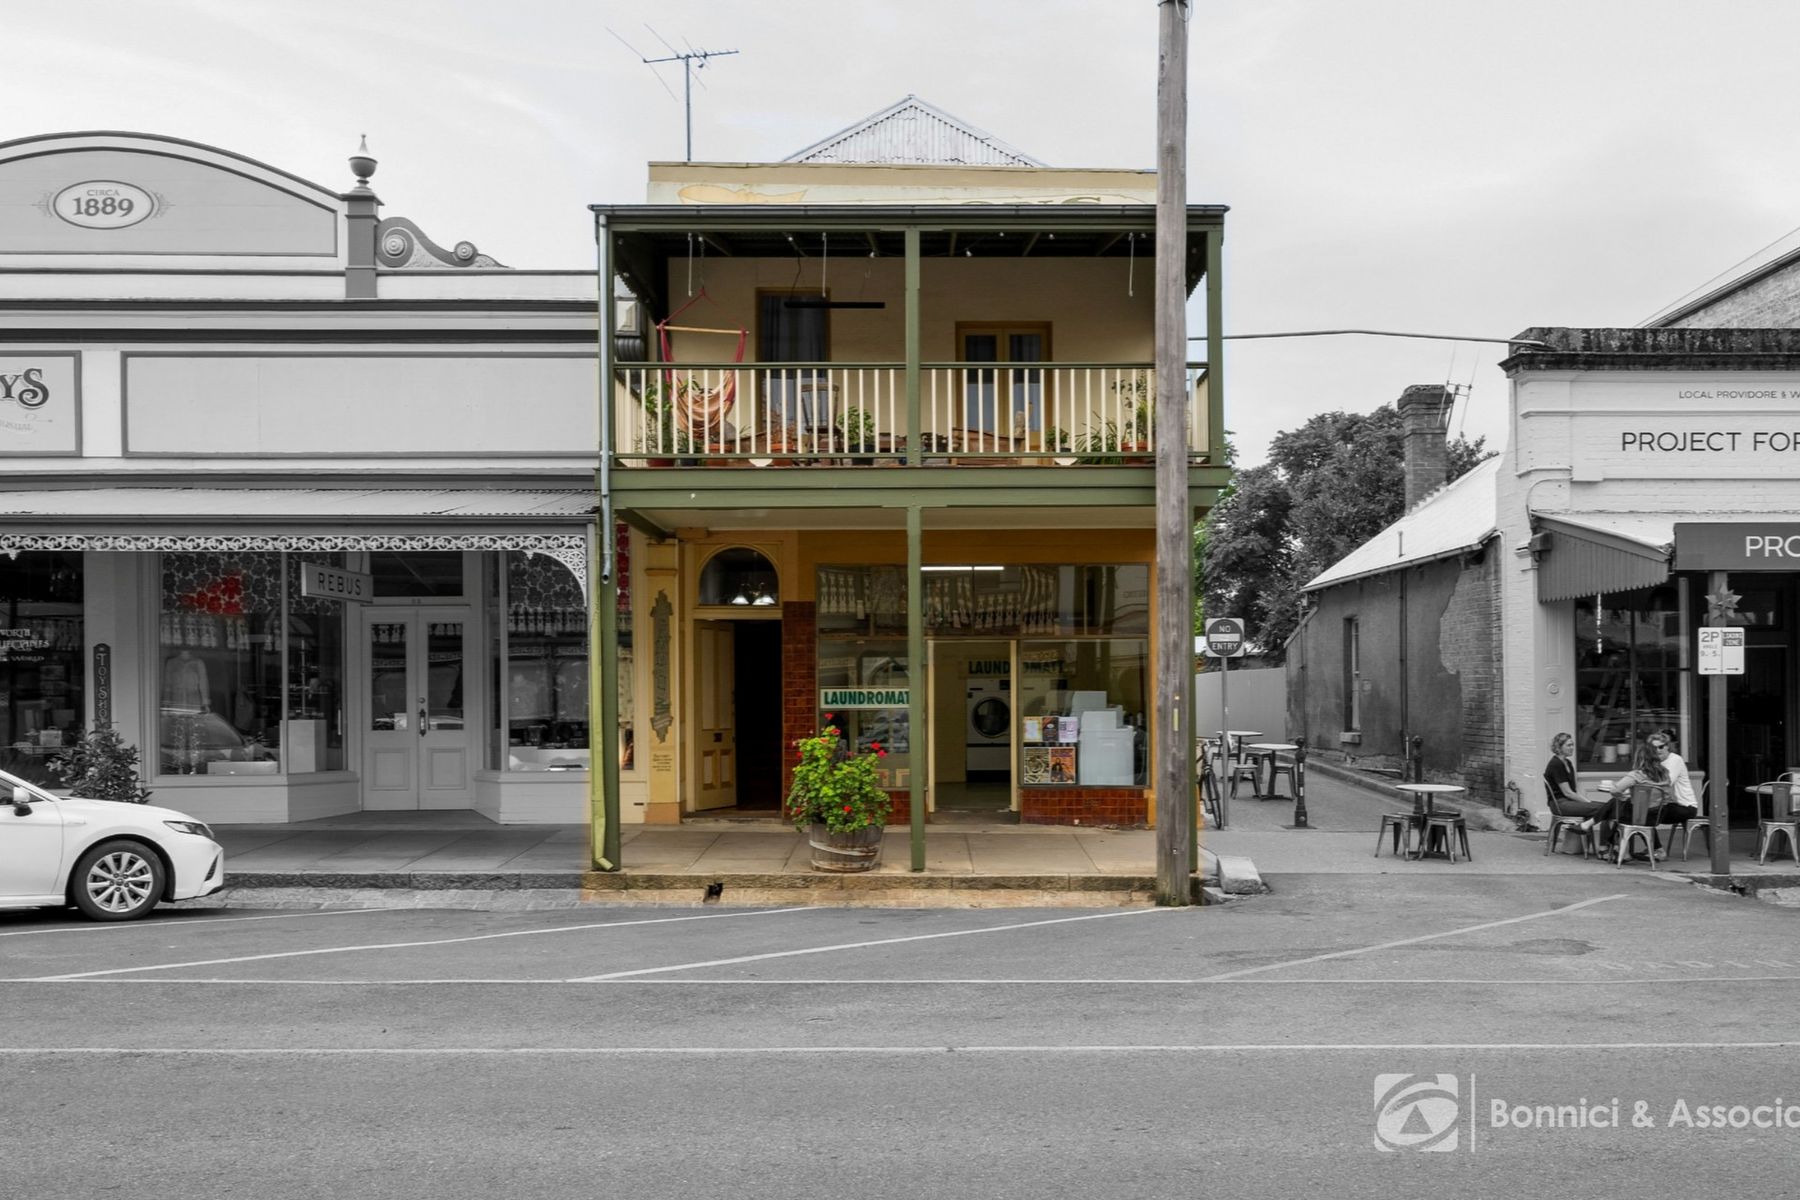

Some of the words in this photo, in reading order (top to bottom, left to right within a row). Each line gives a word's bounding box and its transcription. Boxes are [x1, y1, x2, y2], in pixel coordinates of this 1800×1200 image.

[86, 189, 121, 197] CIRCA
[72, 197, 134, 217] 1889
[1679, 390, 1713, 399] LOCAL
[1716, 390, 1777, 399] PROVIDORE
[1622, 431, 1742, 452] PROJECT
[1745, 535, 1800, 557] PRO
[318, 572, 362, 596] REBUS
[1218, 625, 1231, 633] NO
[1701, 631, 1720, 643] 2P
[1211, 642, 1239, 651] ENTRY
